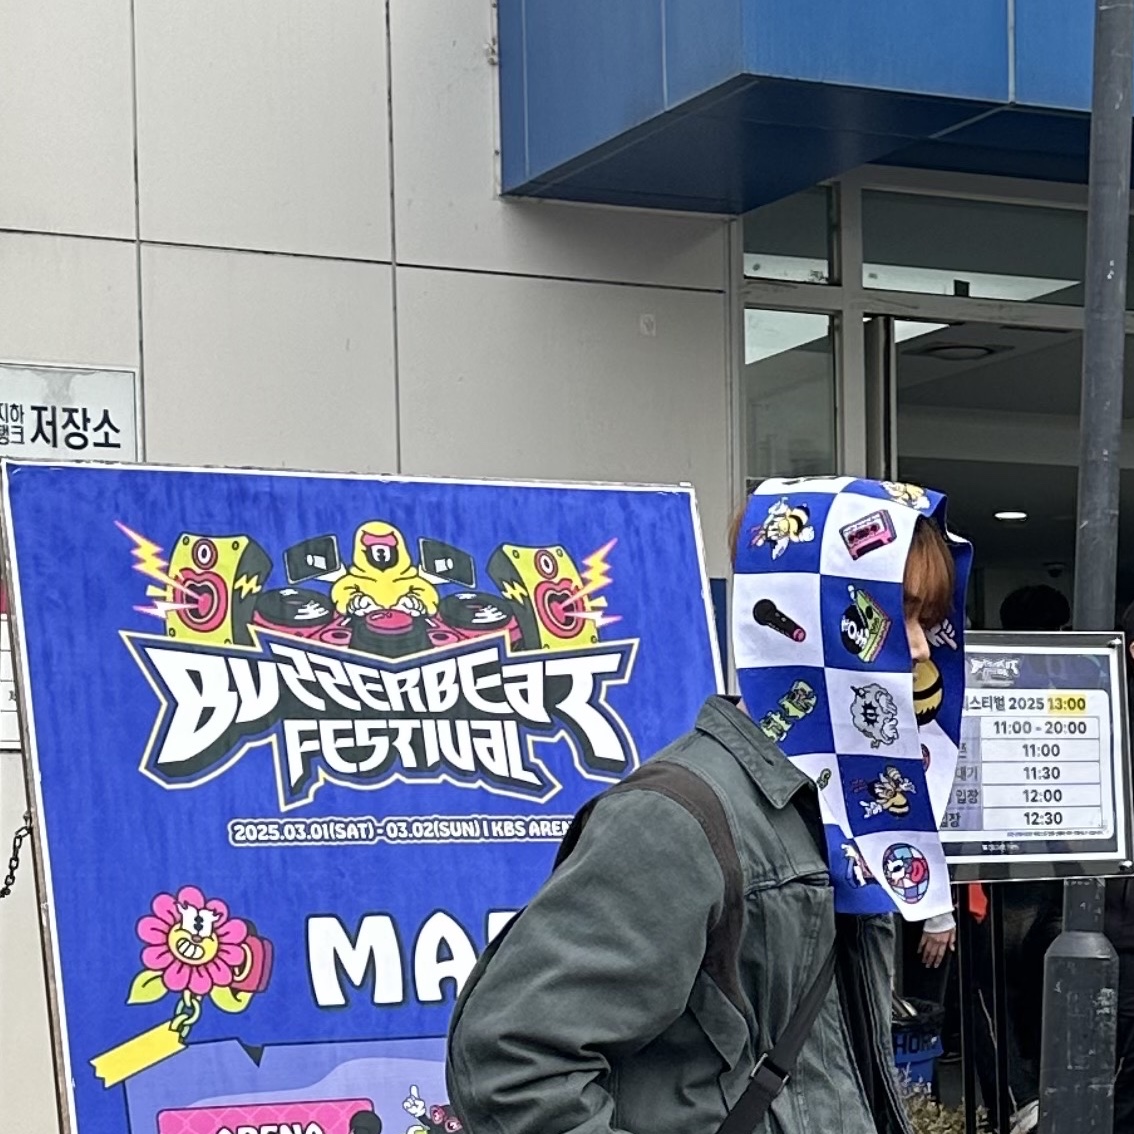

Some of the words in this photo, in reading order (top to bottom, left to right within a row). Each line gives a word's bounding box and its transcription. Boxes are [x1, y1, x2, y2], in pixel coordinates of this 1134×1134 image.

[30, 405, 121, 450] 저장소
[964, 696, 1005, 712] 스티벌
[1008, 698, 1044, 711] 2025
[1049, 697, 1086, 711] 13:00
[994, 721, 1032, 735] 11:00
[1045, 721, 1087, 735] 20:00
[1022, 744, 1060, 758] 11:00
[1023, 767, 1061, 781] 11:30
[1022, 789, 1063, 803] 12:00
[1023, 812, 1063, 826] 12:30
[492, 820, 526, 838] KBS
[529, 819, 573, 837] AREN
[307, 910, 518, 1007] MA
